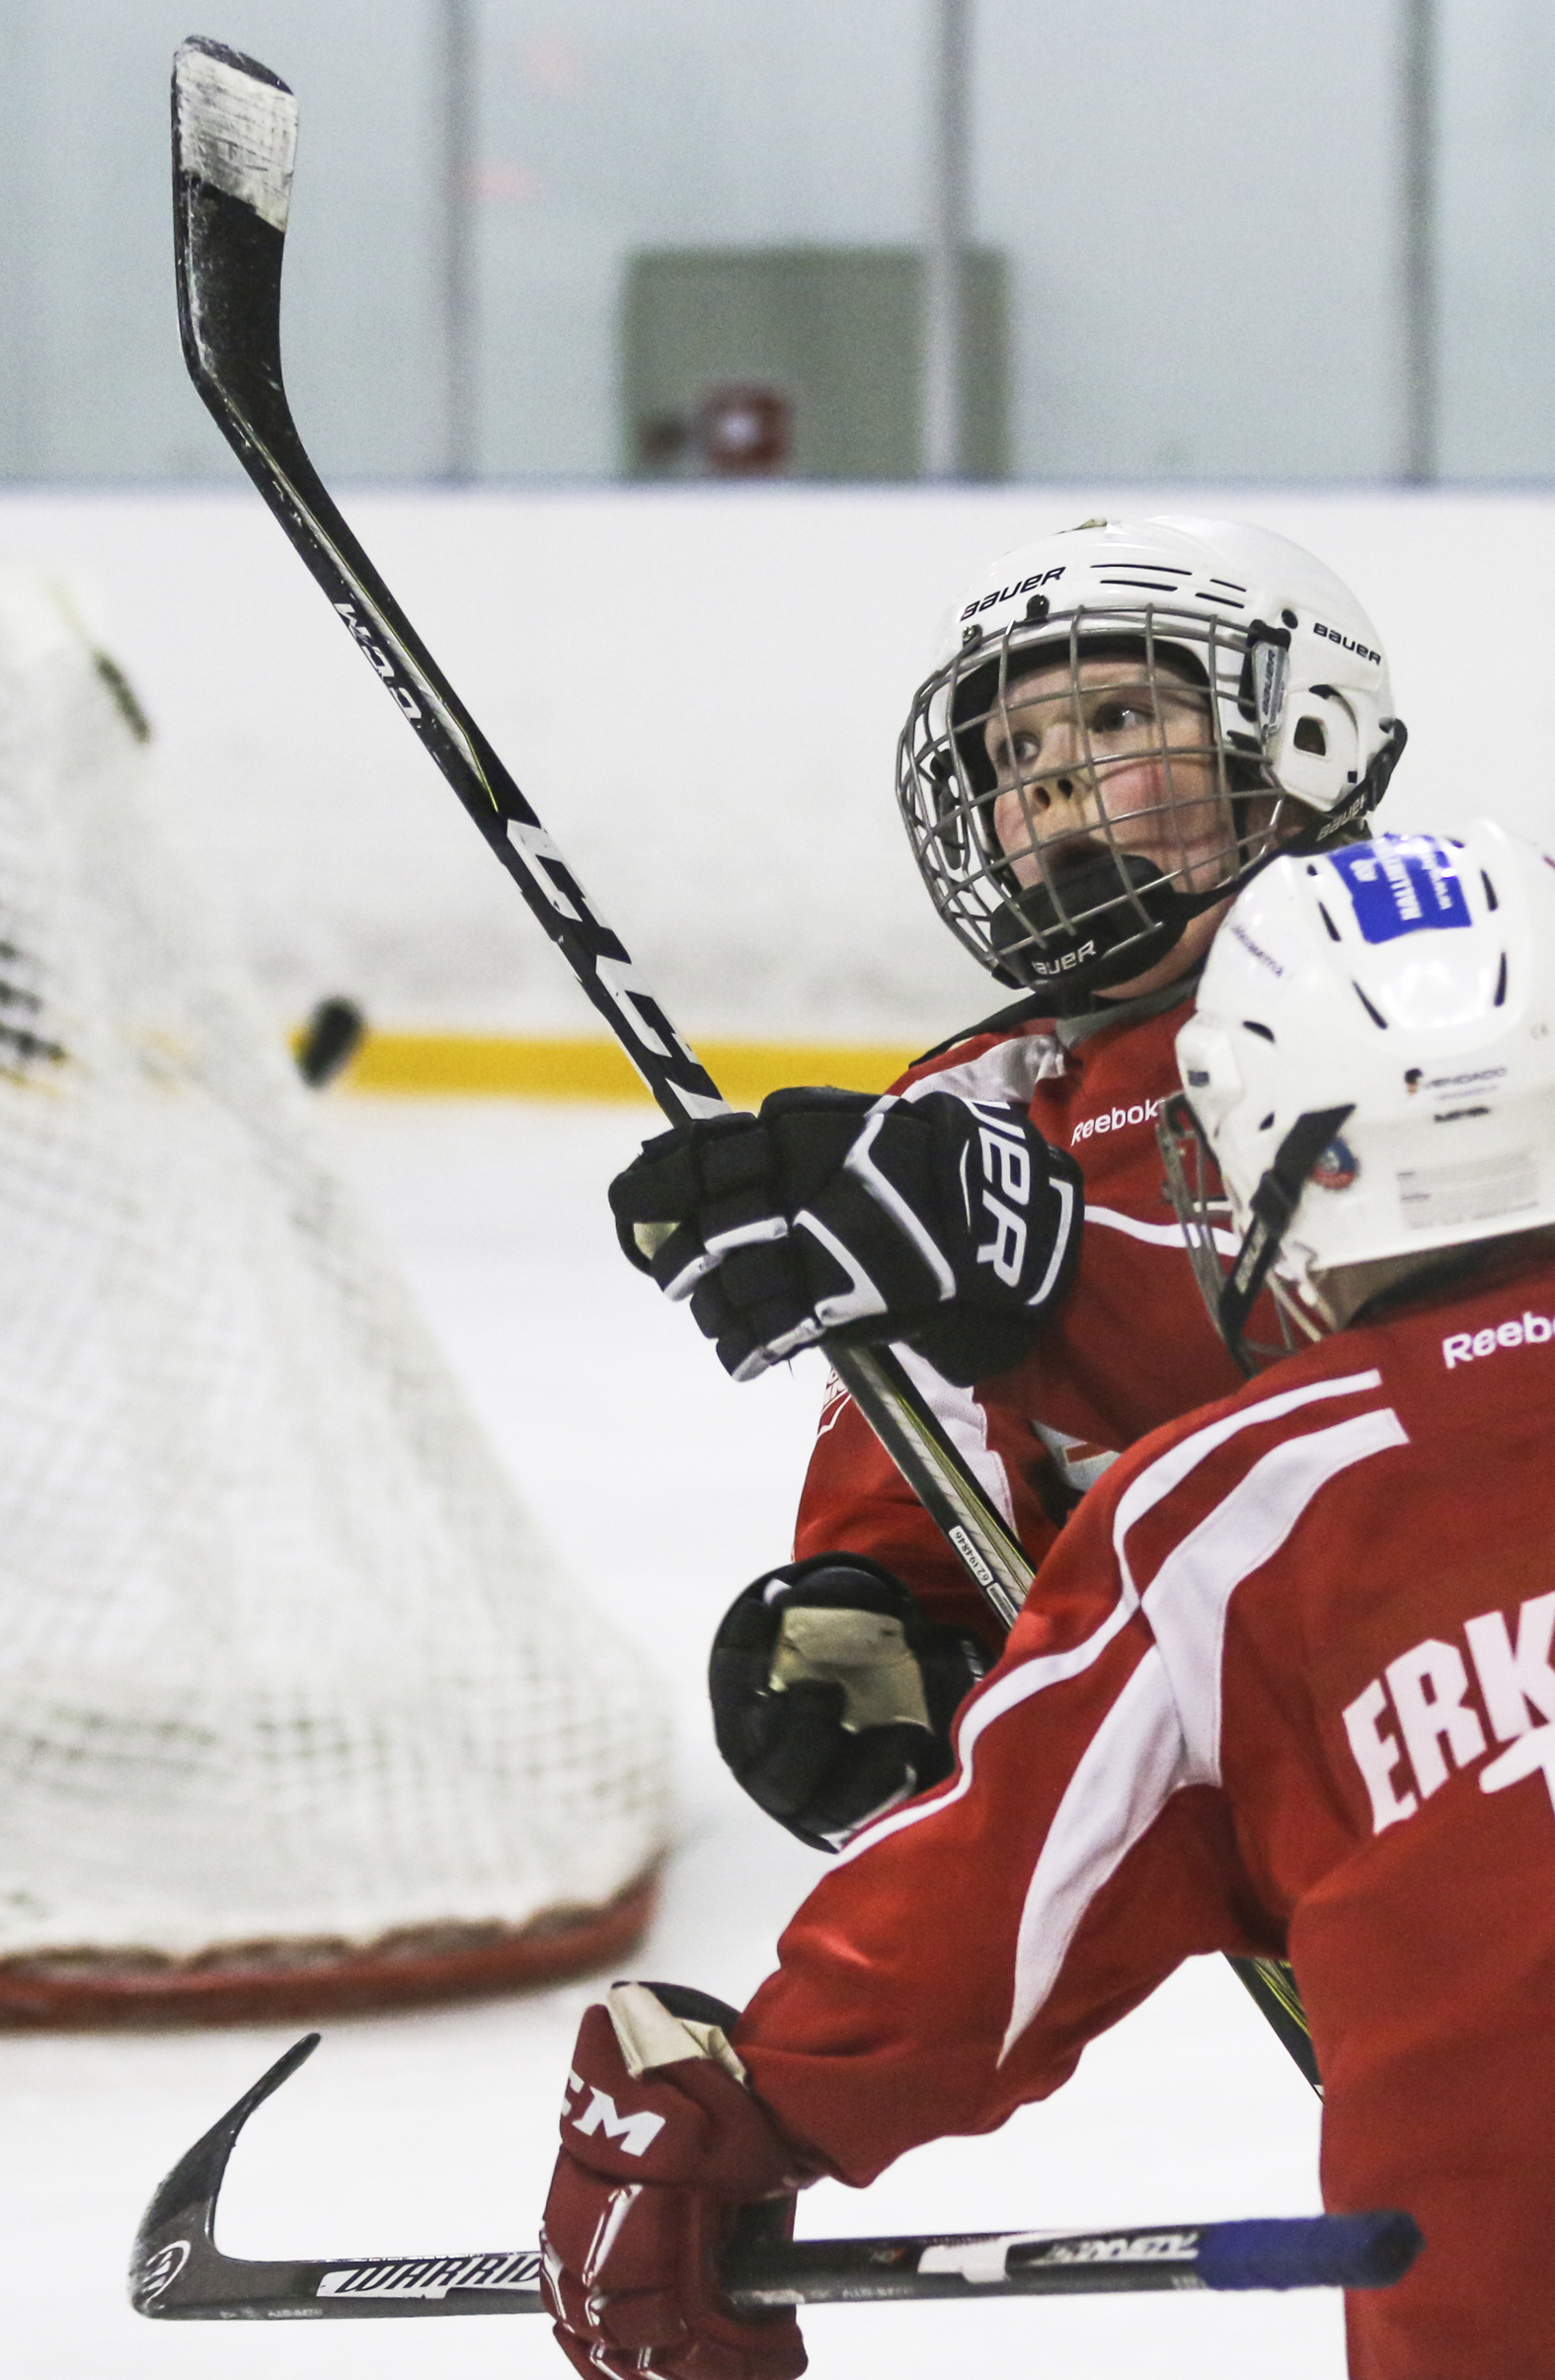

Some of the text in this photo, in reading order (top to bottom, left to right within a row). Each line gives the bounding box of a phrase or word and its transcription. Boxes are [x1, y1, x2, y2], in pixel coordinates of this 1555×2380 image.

[960, 566, 1066, 621] BAUER
[334, 602, 423, 721] CCM
[1313, 622, 1381, 666] BAUER
[506, 818, 733, 1120] CC
[1031, 939, 1097, 975] AUER
[1070, 1098, 1158, 1147] Reebok
[1442, 1311, 1555, 1370] Reeb
